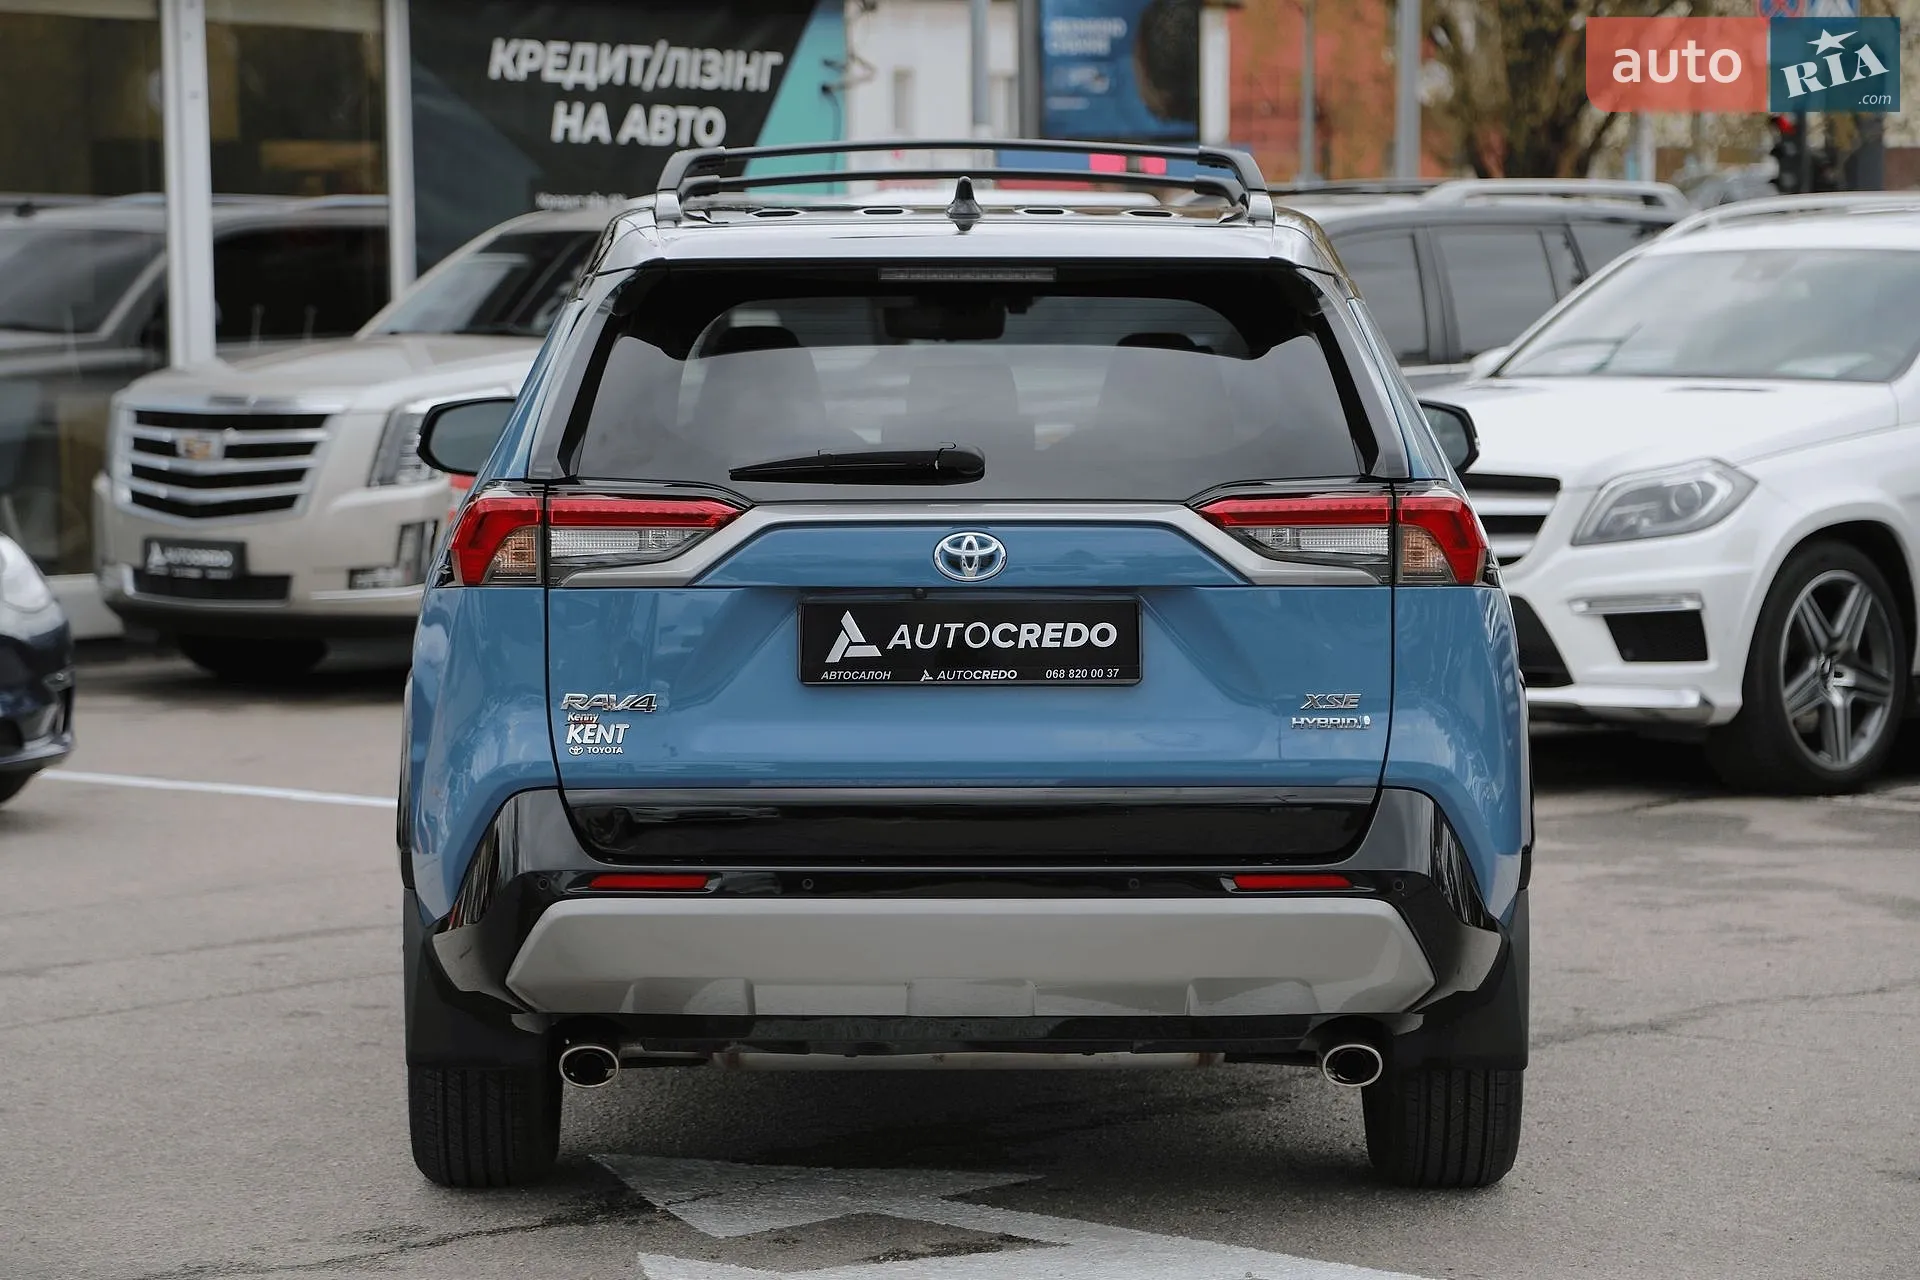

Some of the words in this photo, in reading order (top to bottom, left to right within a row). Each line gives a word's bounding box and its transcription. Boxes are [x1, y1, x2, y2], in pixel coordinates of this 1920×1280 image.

[488, 37, 783, 92] КРЕДИТ/ЛІЗІНГ
[551, 101, 612, 144] НА
[616, 103, 727, 147] АВТО
[886, 621, 1118, 649] AUTOCREDO
[820, 670, 891, 681] АВТОСАЛОН
[937, 669, 1018, 680] AUTOCREDO
[1045, 669, 1065, 679] 068
[1068, 669, 1088, 679] 820
[1090, 669, 1104, 678] 00
[1106, 668, 1120, 678] 37
[560, 693, 658, 712] RAV4
[1300, 693, 1362, 709] XSE
[567, 712, 599, 723] Kenny
[1291, 717, 1361, 729] HYBRID
[566, 723, 630, 744] KENT
[586, 745, 624, 755] TOYOTA
